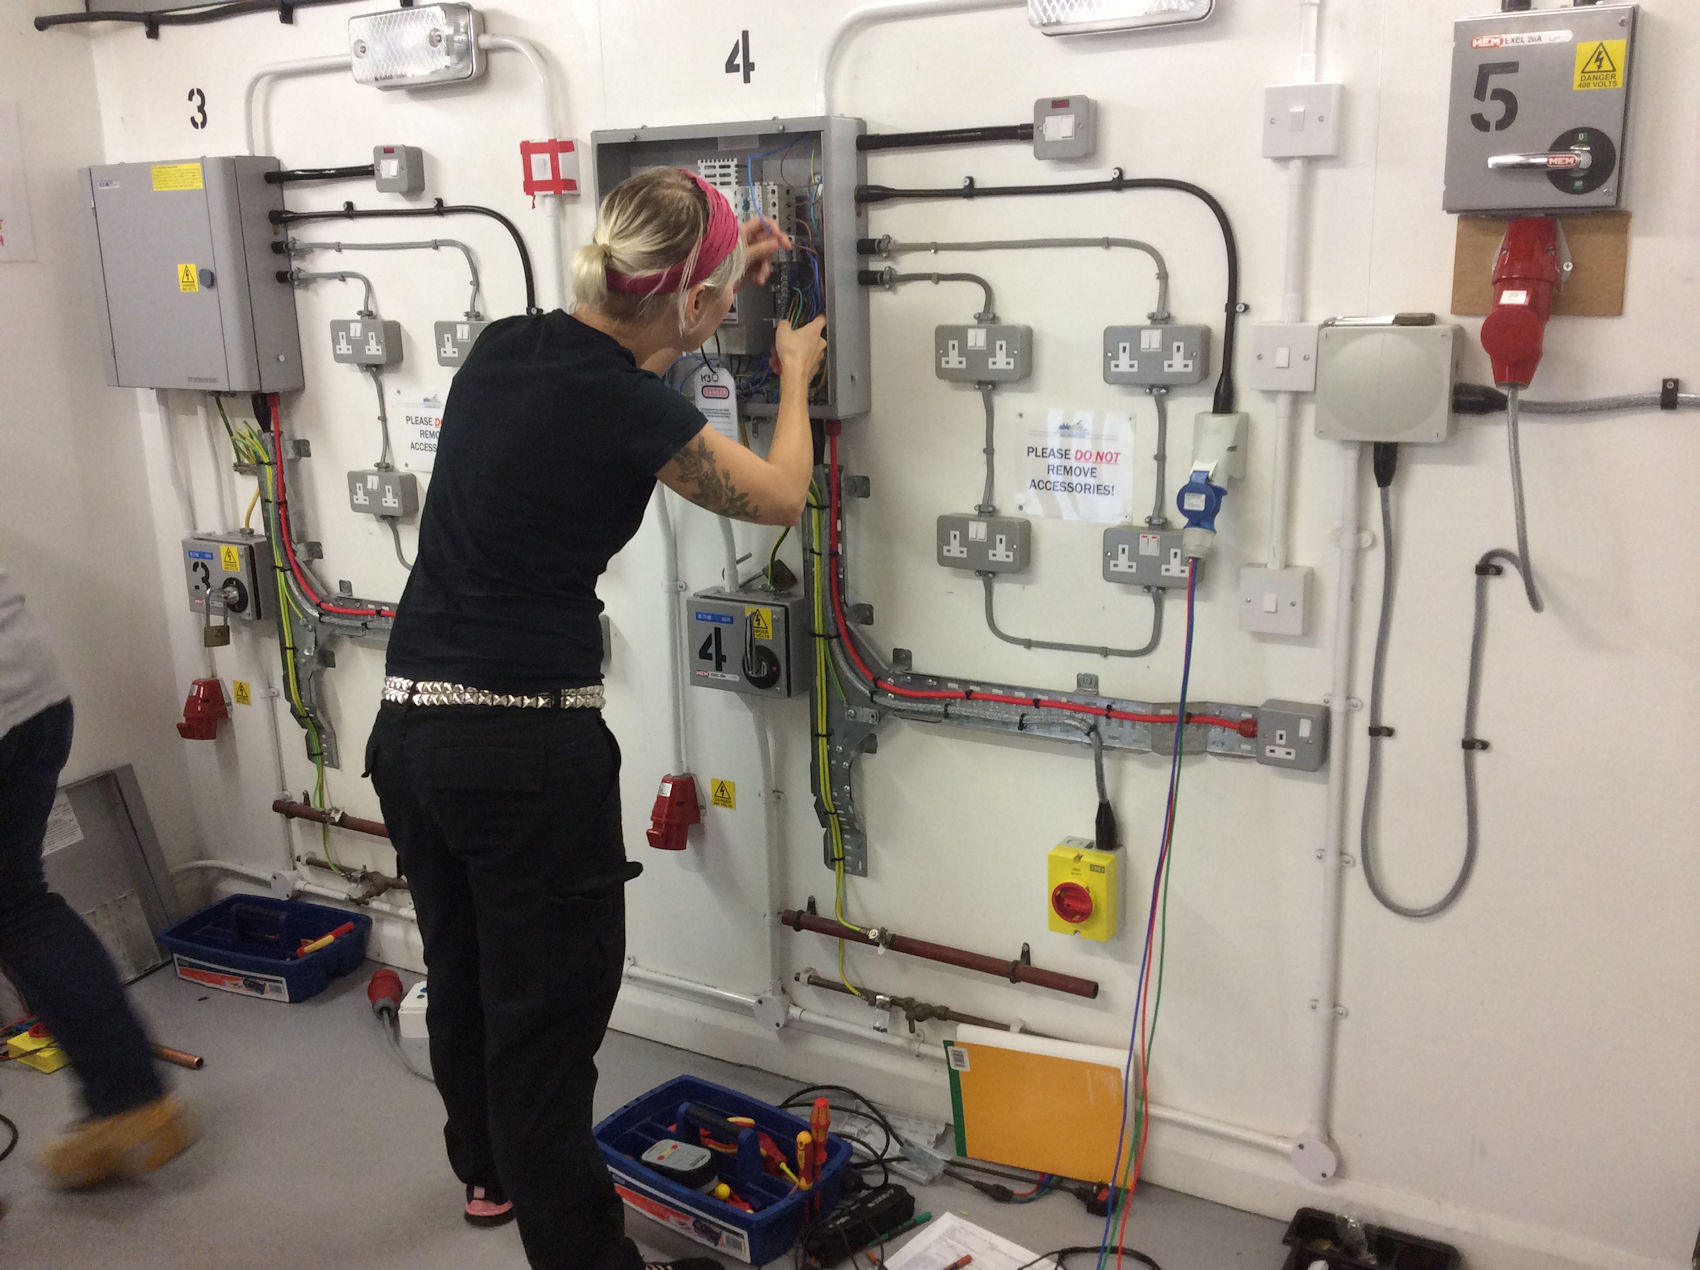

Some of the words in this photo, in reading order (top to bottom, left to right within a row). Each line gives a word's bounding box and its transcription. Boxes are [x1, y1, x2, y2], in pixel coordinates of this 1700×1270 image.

[1472, 38, 1500, 48] MEM
[725, 30, 755, 83] 4
[1580, 73, 1617, 81] DANGER
[1593, 80, 1618, 88] VOLTS
[1470, 61, 1519, 132] 5
[188, 87, 207, 130] 3
[1549, 157, 1574, 165] MEM
[405, 415, 433, 426] PLEASE
[1027, 446, 1071, 460] PLEASE
[1074, 449, 1092, 462] DO
[1095, 451, 1121, 463] NOT
[1047, 464, 1097, 478] REMOVE
[1029, 479, 1115, 496] ACCESSORIES!
[698, 627, 727, 672] 4
